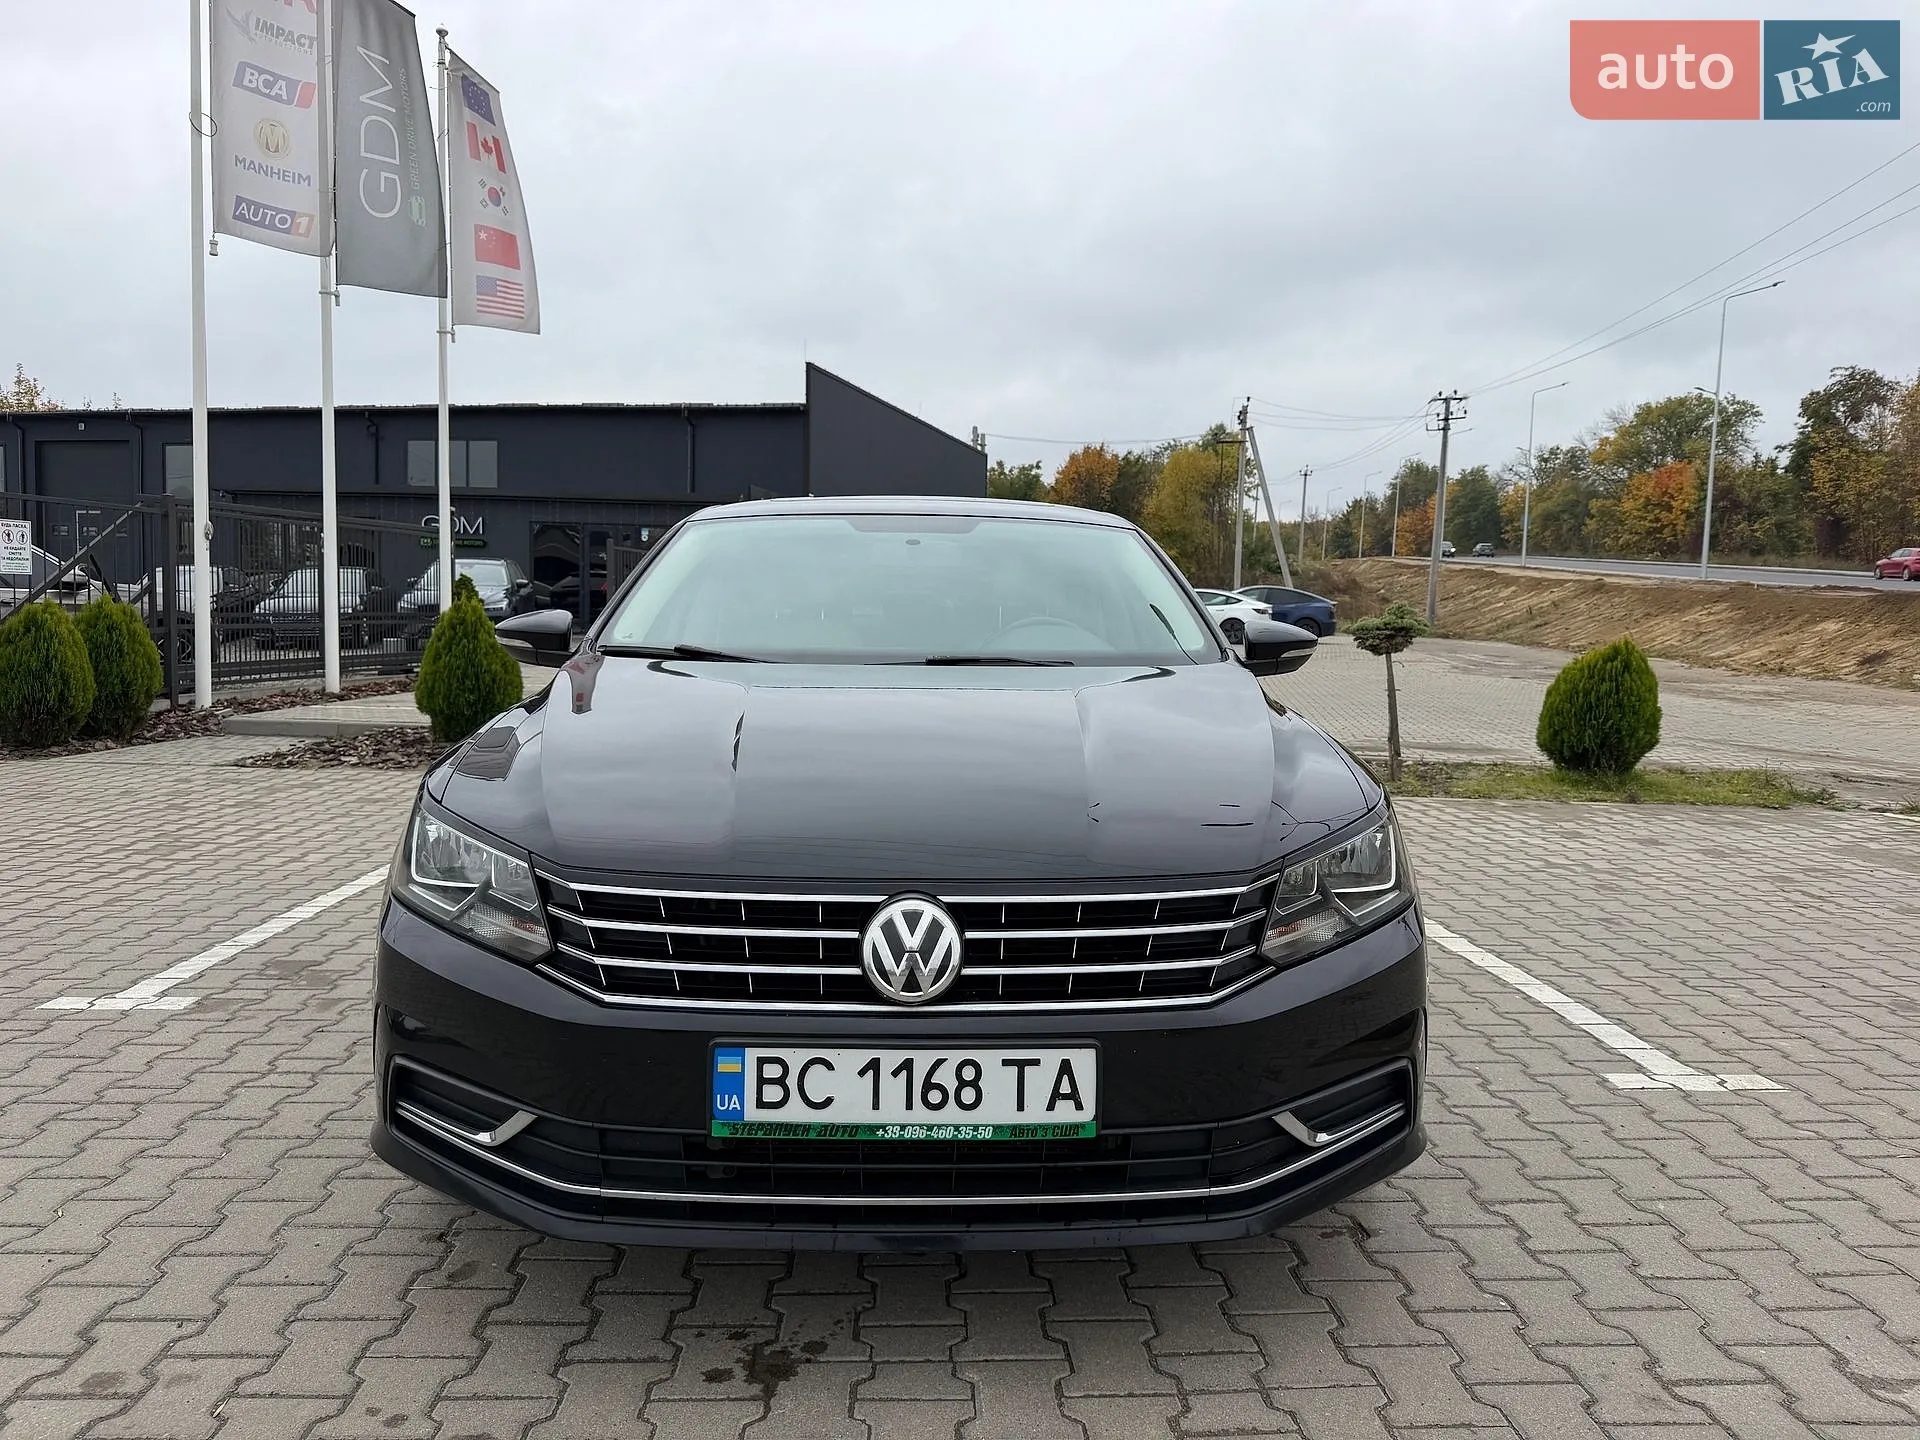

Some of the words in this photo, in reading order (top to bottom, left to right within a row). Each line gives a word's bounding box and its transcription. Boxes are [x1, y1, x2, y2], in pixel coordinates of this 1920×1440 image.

[254, 16, 318, 50] IMPACT
[242, 66, 288, 101] BCA
[357, 45, 402, 219] GDM
[234, 153, 312, 187] MANHEIM
[409, 151, 420, 190] GREEN
[755, 1056, 836, 1111] BC
[857, 1057, 983, 1111] 1168
[1001, 1058, 1085, 1112] TA
[716, 1094, 742, 1111] UA
